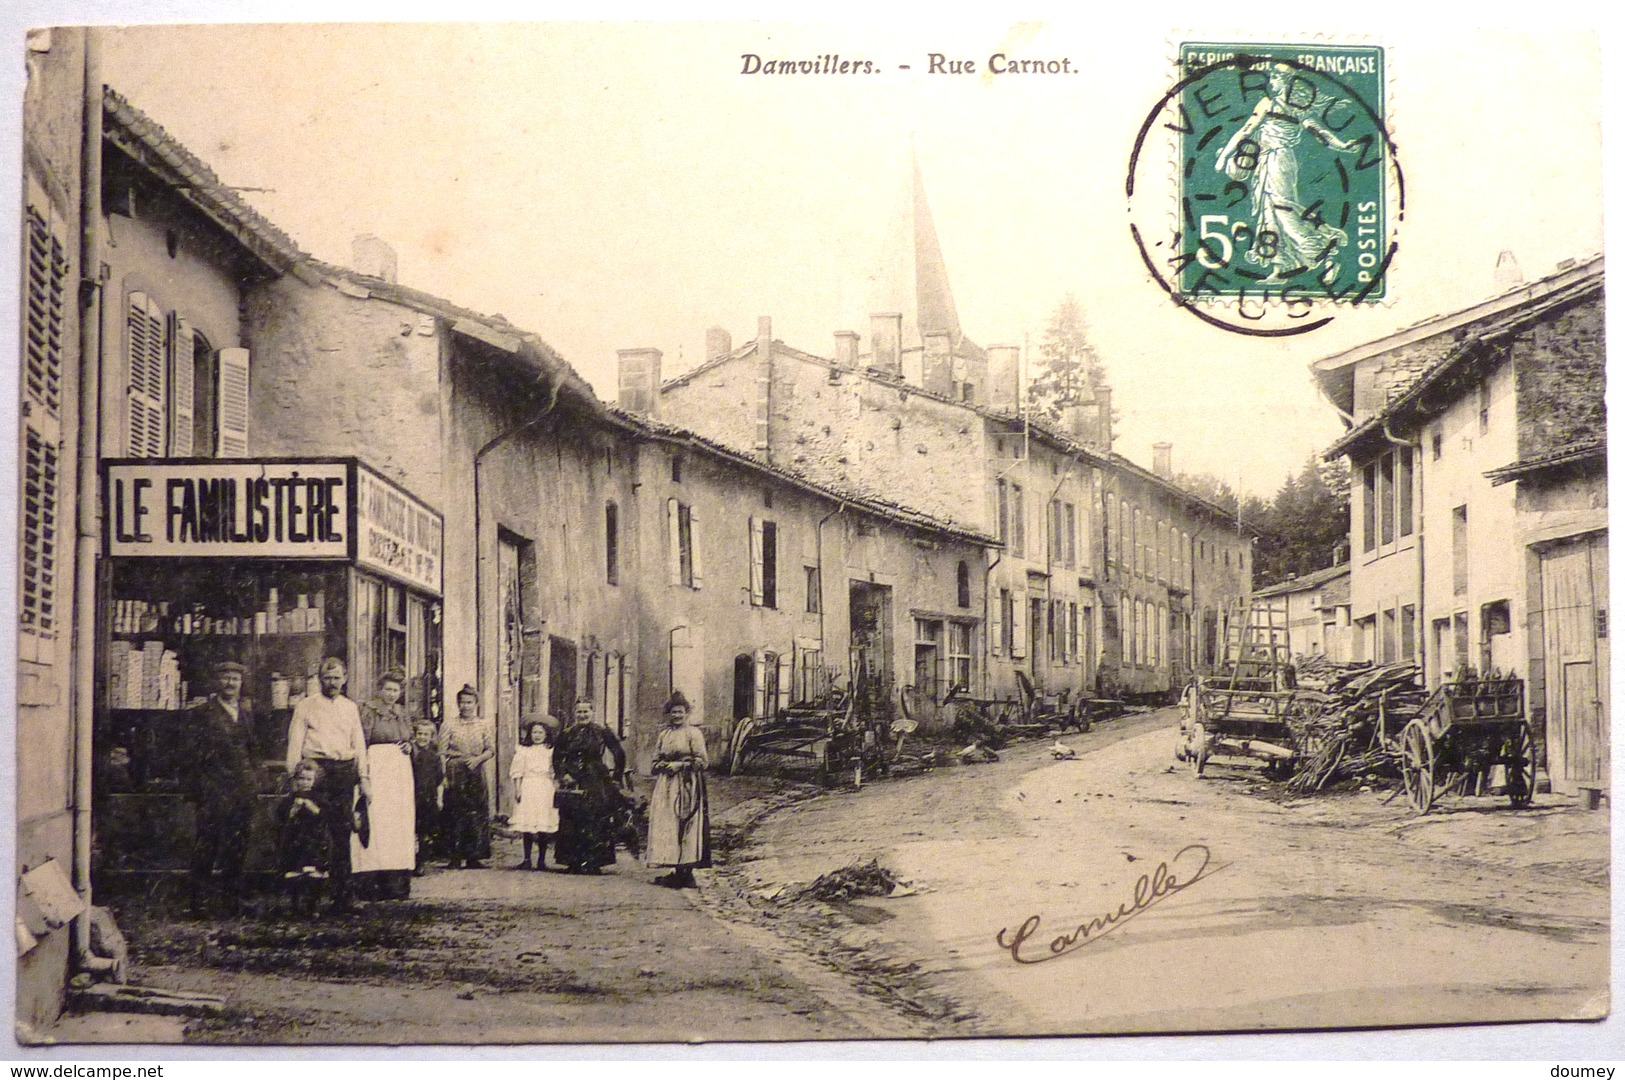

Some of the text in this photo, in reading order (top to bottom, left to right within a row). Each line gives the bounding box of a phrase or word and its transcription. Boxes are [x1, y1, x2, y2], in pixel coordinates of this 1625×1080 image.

[741, 54, 881, 75] Damvillers.
[928, 54, 976, 75] Rue
[988, 53, 1079, 75] Carnot.
[1297, 54, 1376, 75] FRANÇAISE
[1164, 70, 1382, 171] VERDUN
[1357, 200, 1377, 283] POSTES
[116, 477, 152, 543] LE
[166, 470, 343, 544] FAMILISTÈRE
